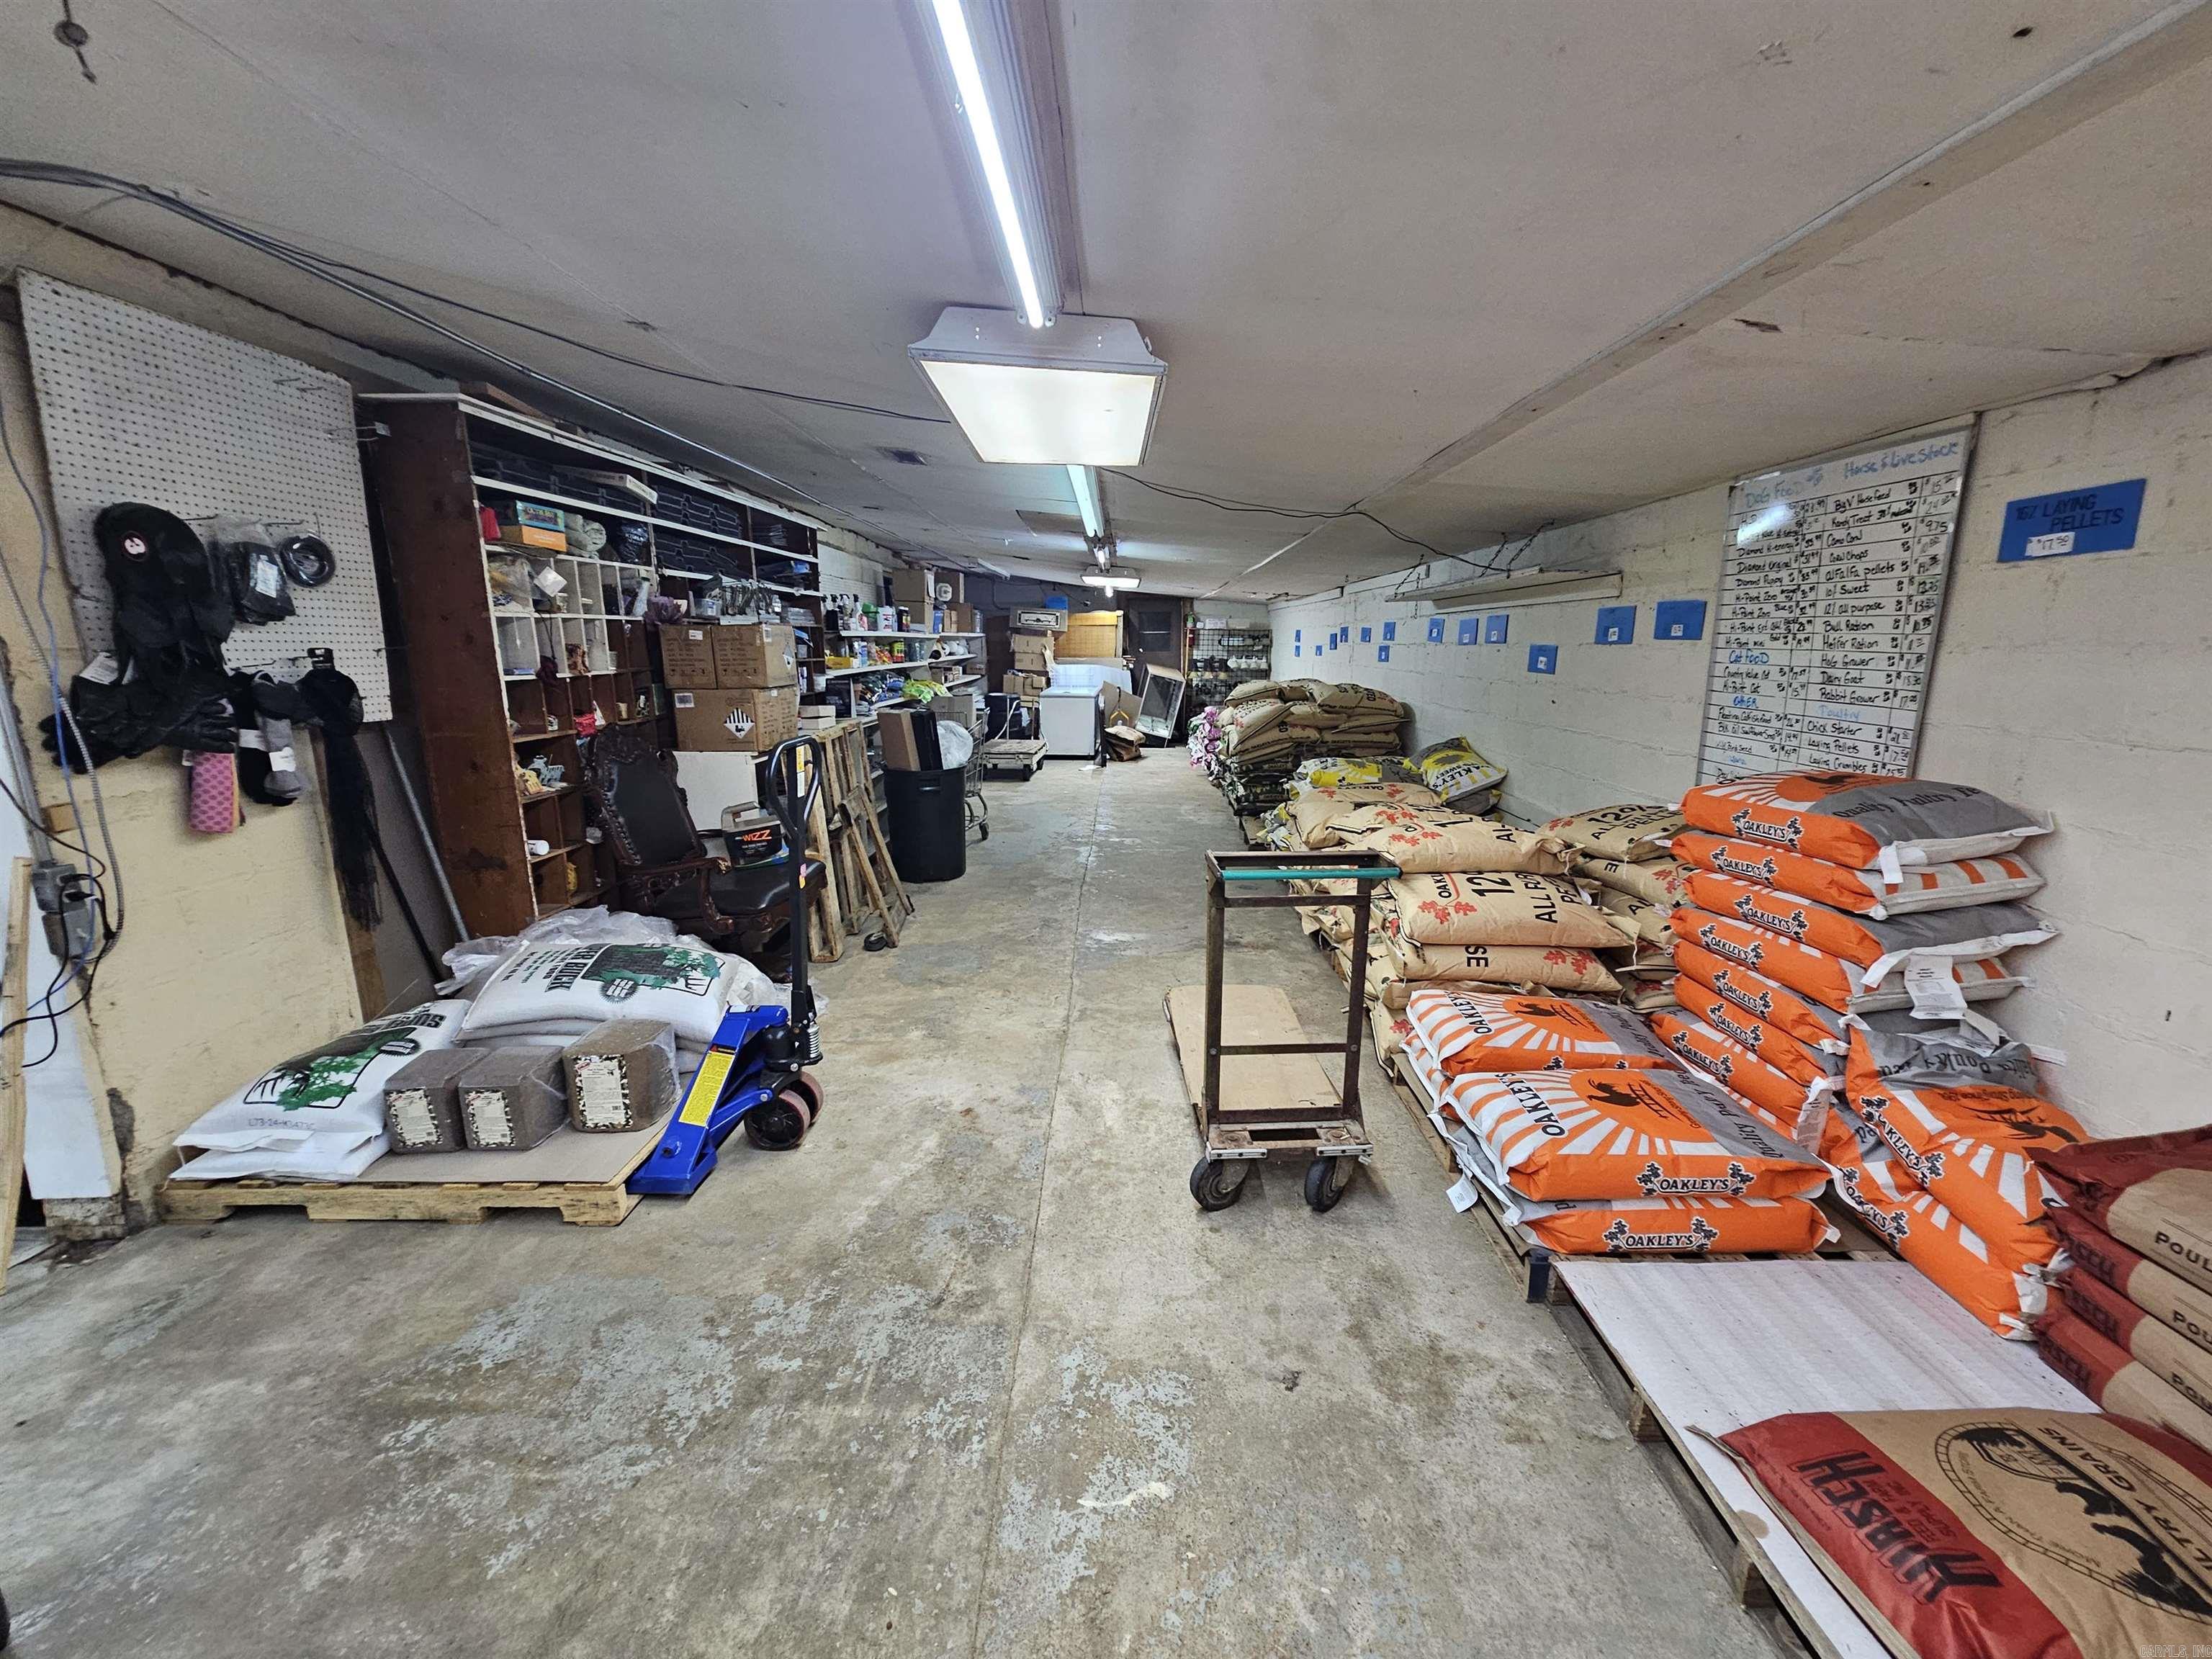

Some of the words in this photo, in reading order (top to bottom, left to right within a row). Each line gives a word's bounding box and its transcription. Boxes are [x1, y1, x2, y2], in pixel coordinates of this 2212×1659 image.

[2043, 494, 2097, 517] LAYING
[2051, 508, 2124, 531] PELLETS
[742, 829, 773, 842] WIZZ
[1743, 819, 1787, 840] OAKLEY'S
[1723, 858, 1762, 877] OAKLEY'S
[1531, 894, 1558, 924] ALL
[1747, 907, 1791, 931] OAKLEY'S
[1711, 937, 1749, 961] OAKLEY'S
[544, 961, 589, 992] BUCK
[1723, 982, 1758, 1009] OAKLEY'S
[1717, 1015, 1750, 1042] OAKLEY'S
[1683, 1043, 1719, 1073] OAKLEY'S
[1494, 1073, 1566, 1136] OAKLEY'S
[1660, 1178, 1730, 1192] OAKLEY'S
[1625, 1234, 1694, 1248] OAKLEY'S
[2037, 1427, 2137, 1493] GRAINS
[1789, 1450, 2004, 1604] HIRSCH
